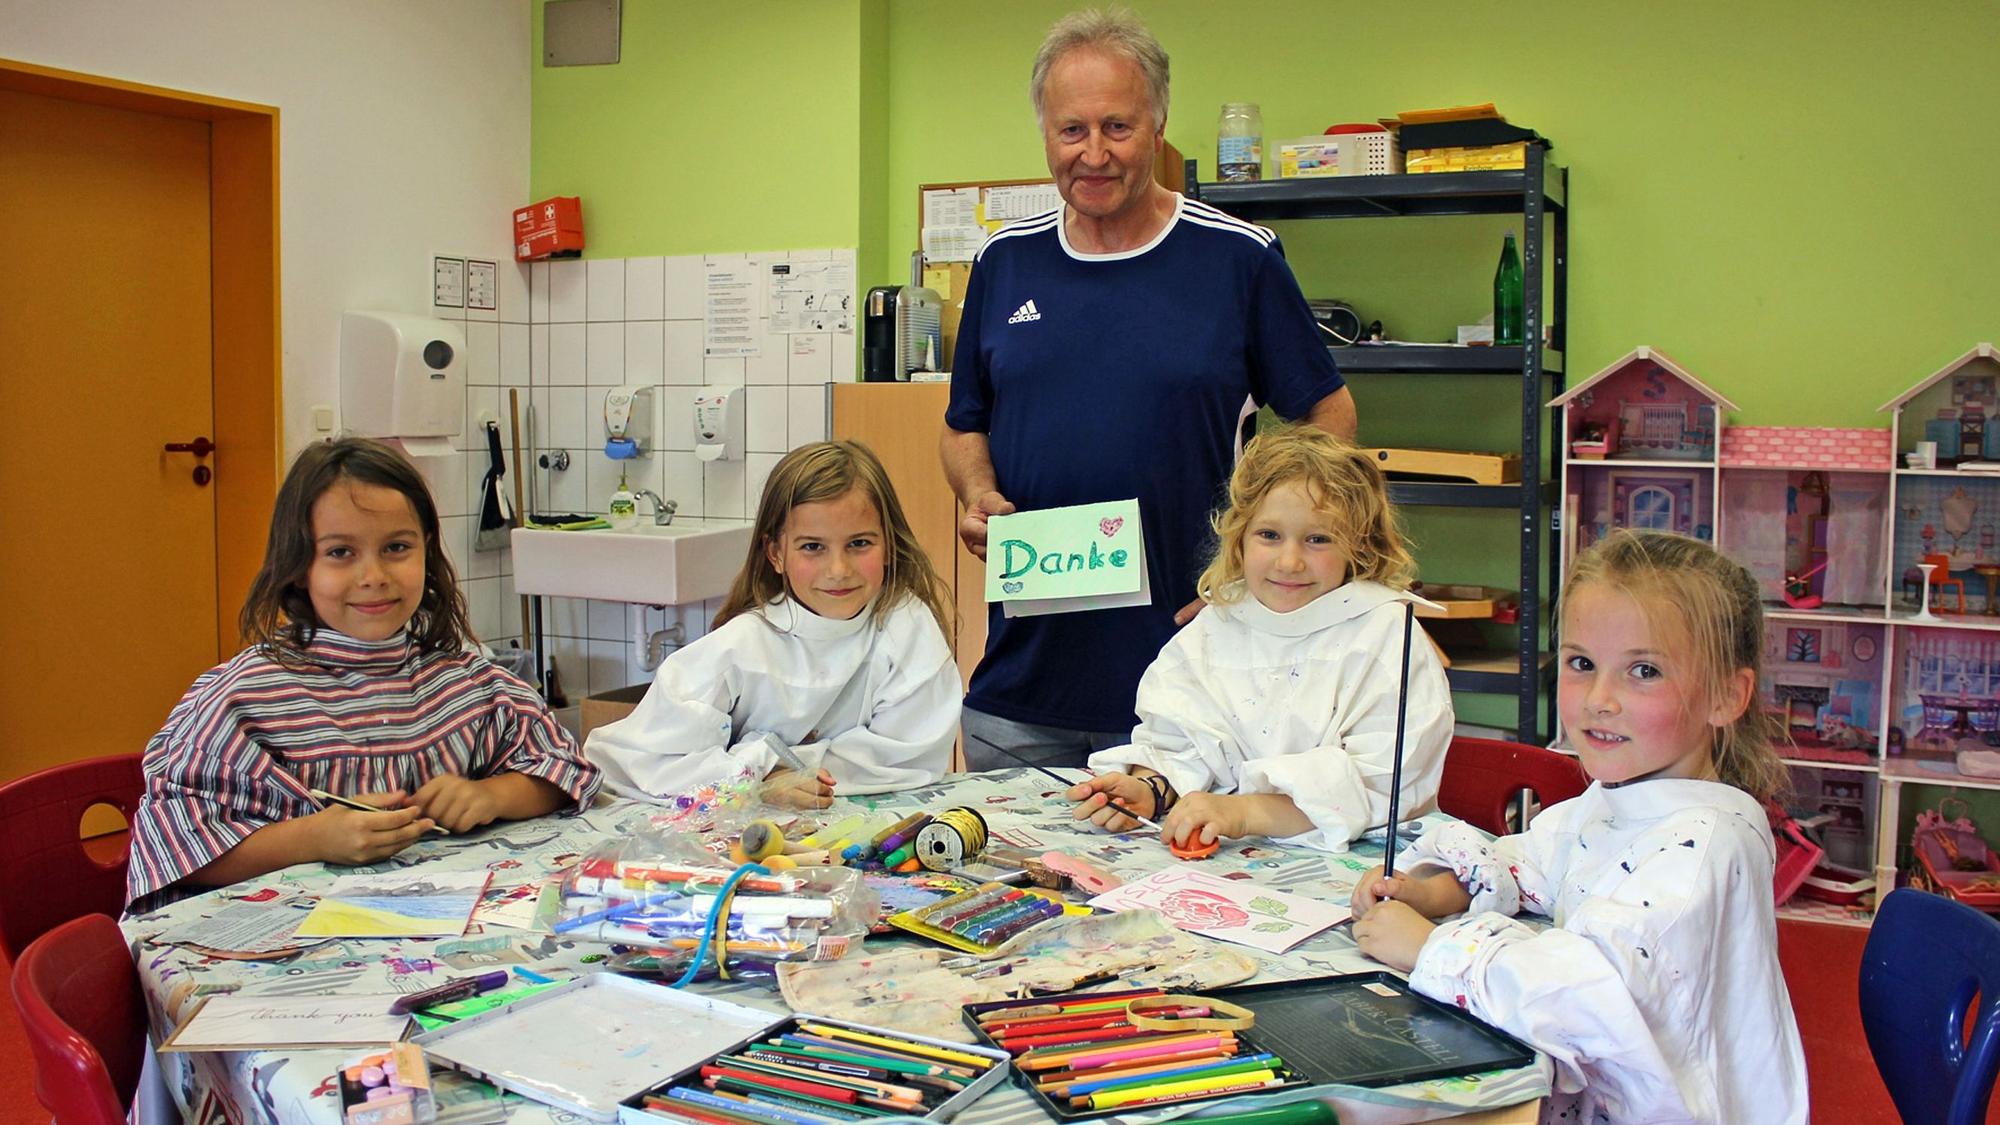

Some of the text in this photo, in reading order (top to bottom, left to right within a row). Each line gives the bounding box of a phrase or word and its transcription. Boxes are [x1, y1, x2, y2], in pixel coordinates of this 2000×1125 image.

[1008, 312, 1041, 324] adidas
[999, 539, 1128, 580] Danke
[334, 1012, 374, 1024] you
